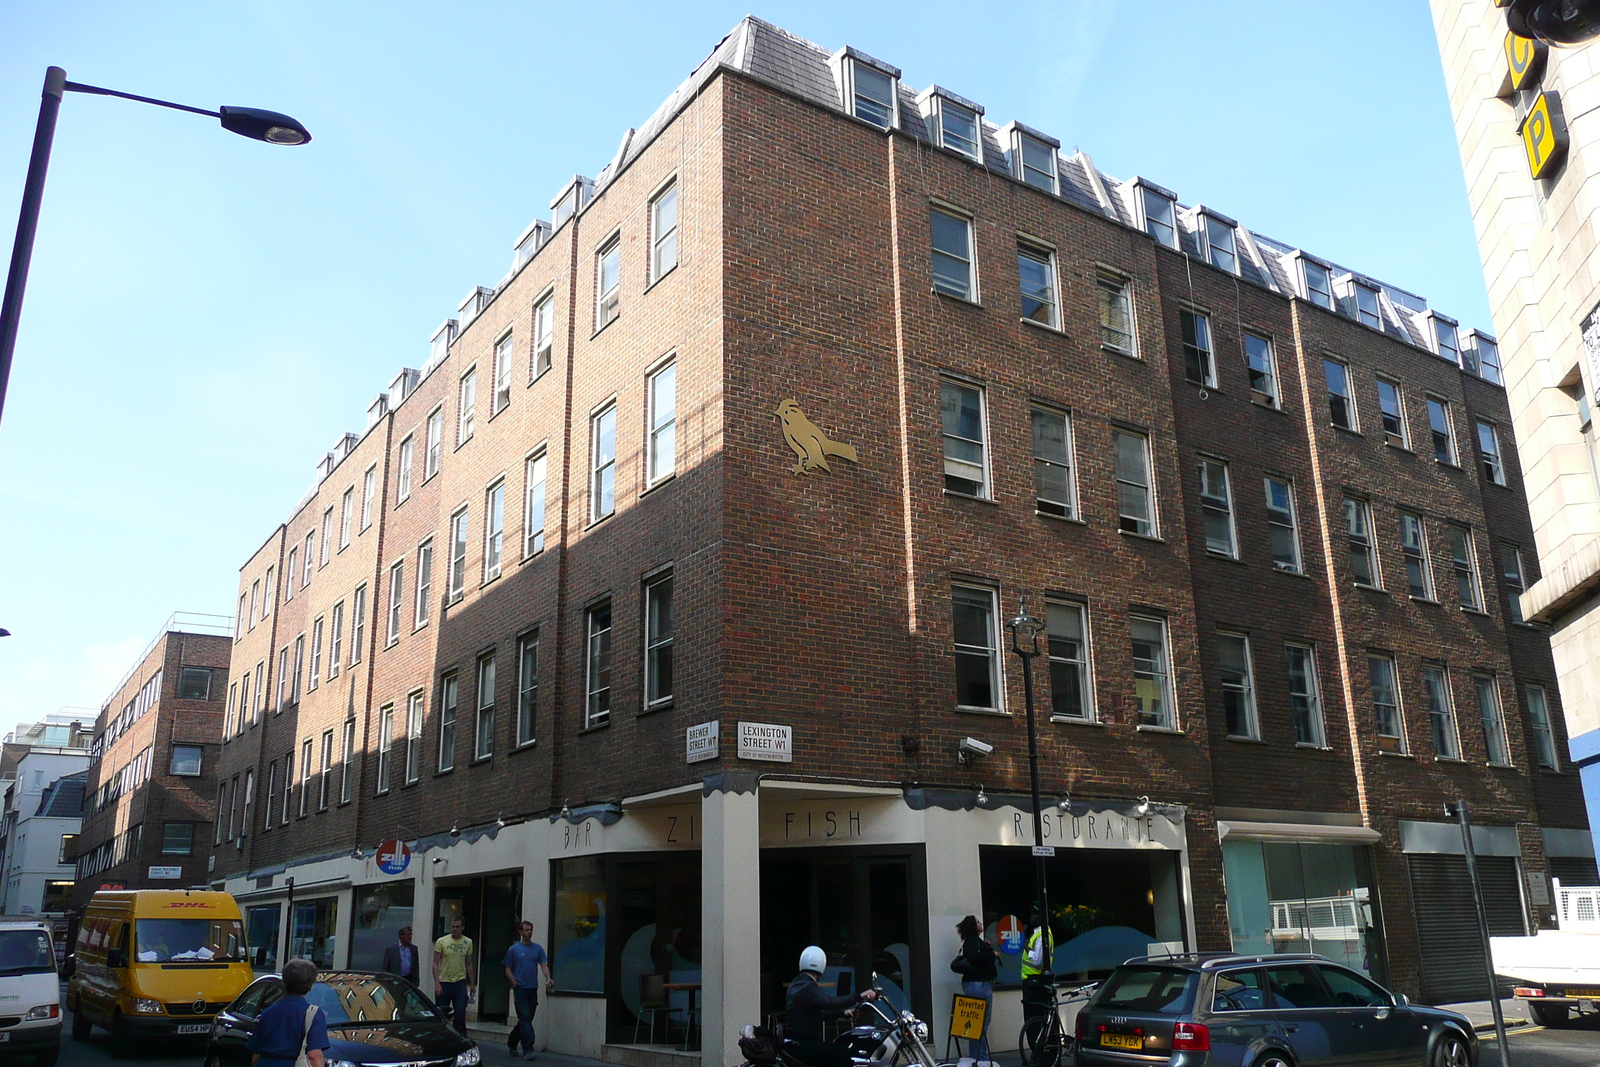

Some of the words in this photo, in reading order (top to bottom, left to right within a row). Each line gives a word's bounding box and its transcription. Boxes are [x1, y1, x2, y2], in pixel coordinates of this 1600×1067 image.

[689, 726, 709, 740] BREWER
[742, 725, 787, 739] LEXINGTON
[689, 739, 706, 751] STREET
[743, 737, 772, 749] STREET
[774, 740, 786, 750] W1
[758, 752, 784, 760] WESTMINSTER
[785, 810, 861, 839] FISH
[1014, 812, 1155, 842] RISTORANTE
[564, 821, 591, 849] BAR
[958, 998, 984, 1011] Diverted
[960, 1009, 980, 1020] traffic
